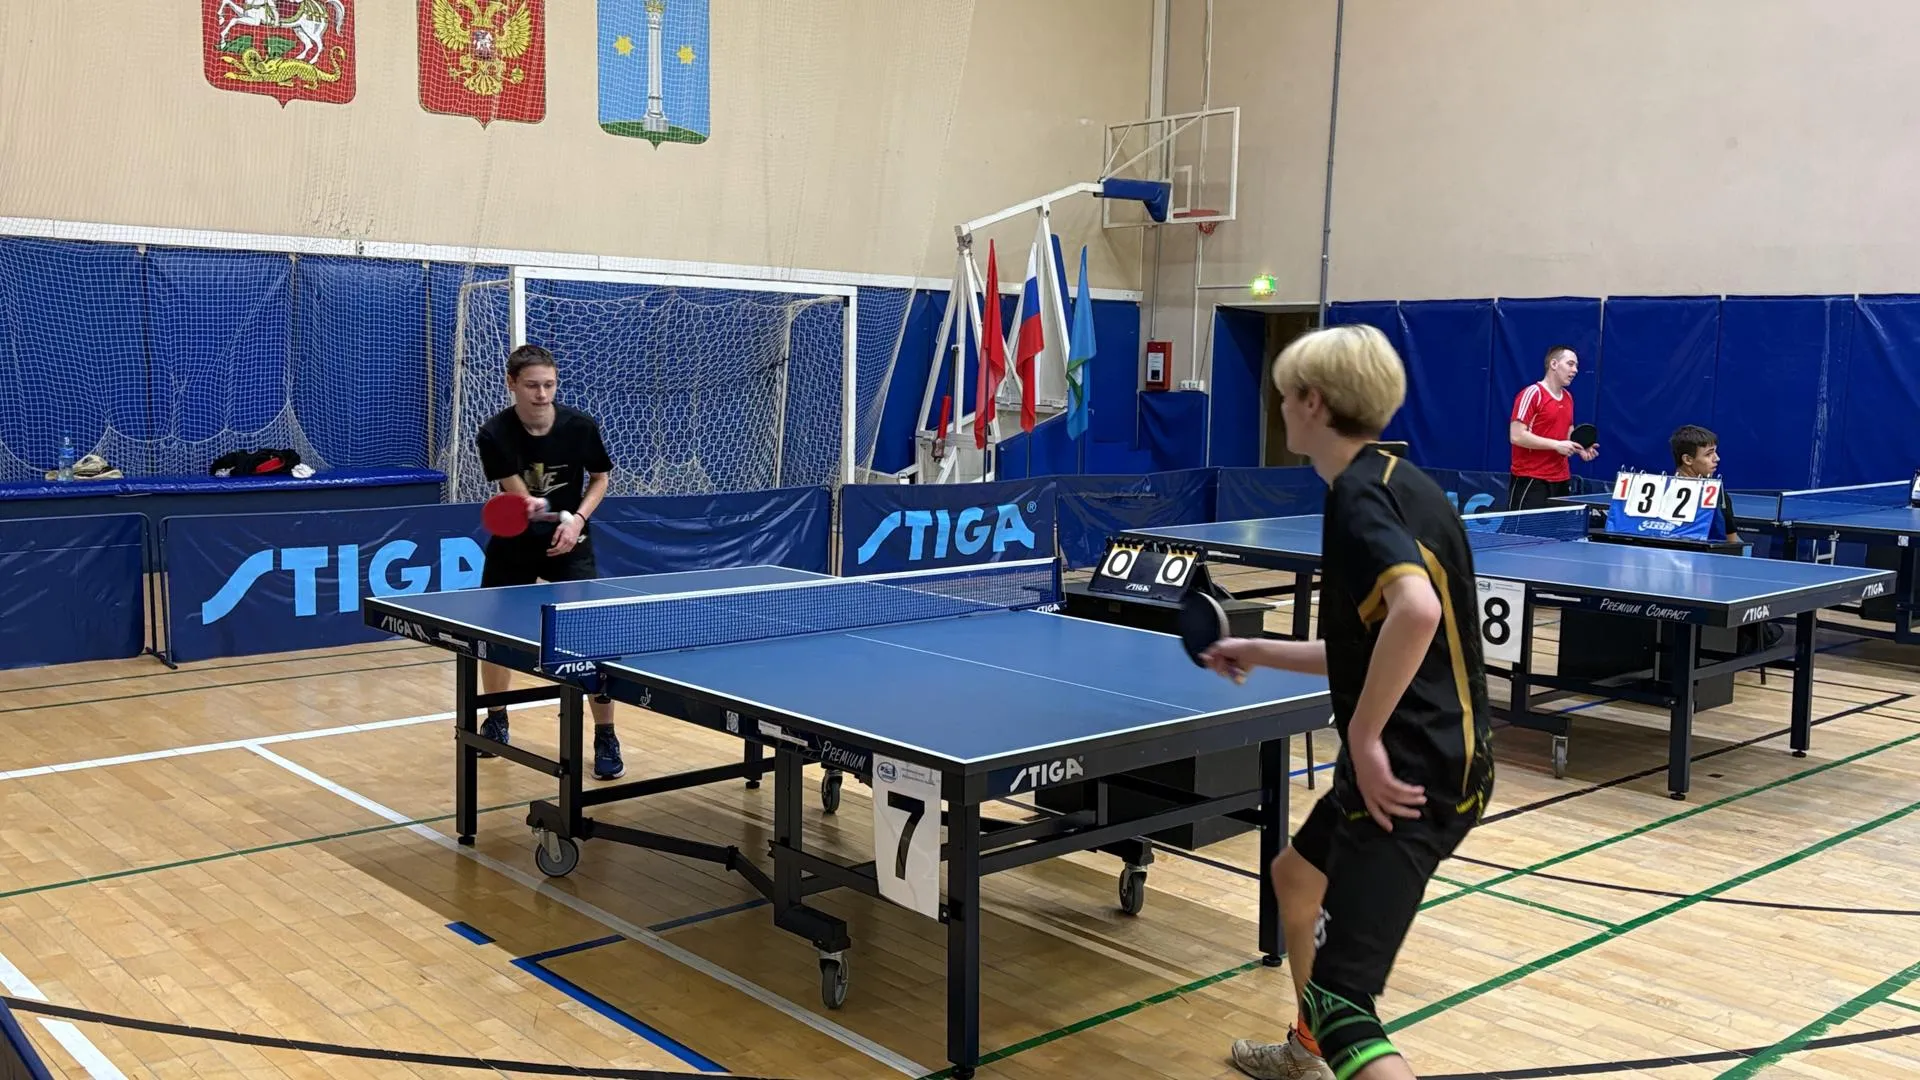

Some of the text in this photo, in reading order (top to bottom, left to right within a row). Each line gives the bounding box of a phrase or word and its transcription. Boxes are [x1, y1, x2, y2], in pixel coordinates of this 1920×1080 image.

[1620, 478, 1717, 519] 1 3 2 2
[202, 537, 486, 625] STIGA
[1107, 550, 1188, 583] 0 0
[1862, 582, 1884, 598] STIGA
[381, 615, 413, 637] STIGA
[1482, 596, 1511, 645] 8
[1742, 606, 1770, 623] STIGA
[555, 661, 596, 675] STIGA
[820, 740, 868, 771] PREMIUM
[888, 790, 925, 881] 7
